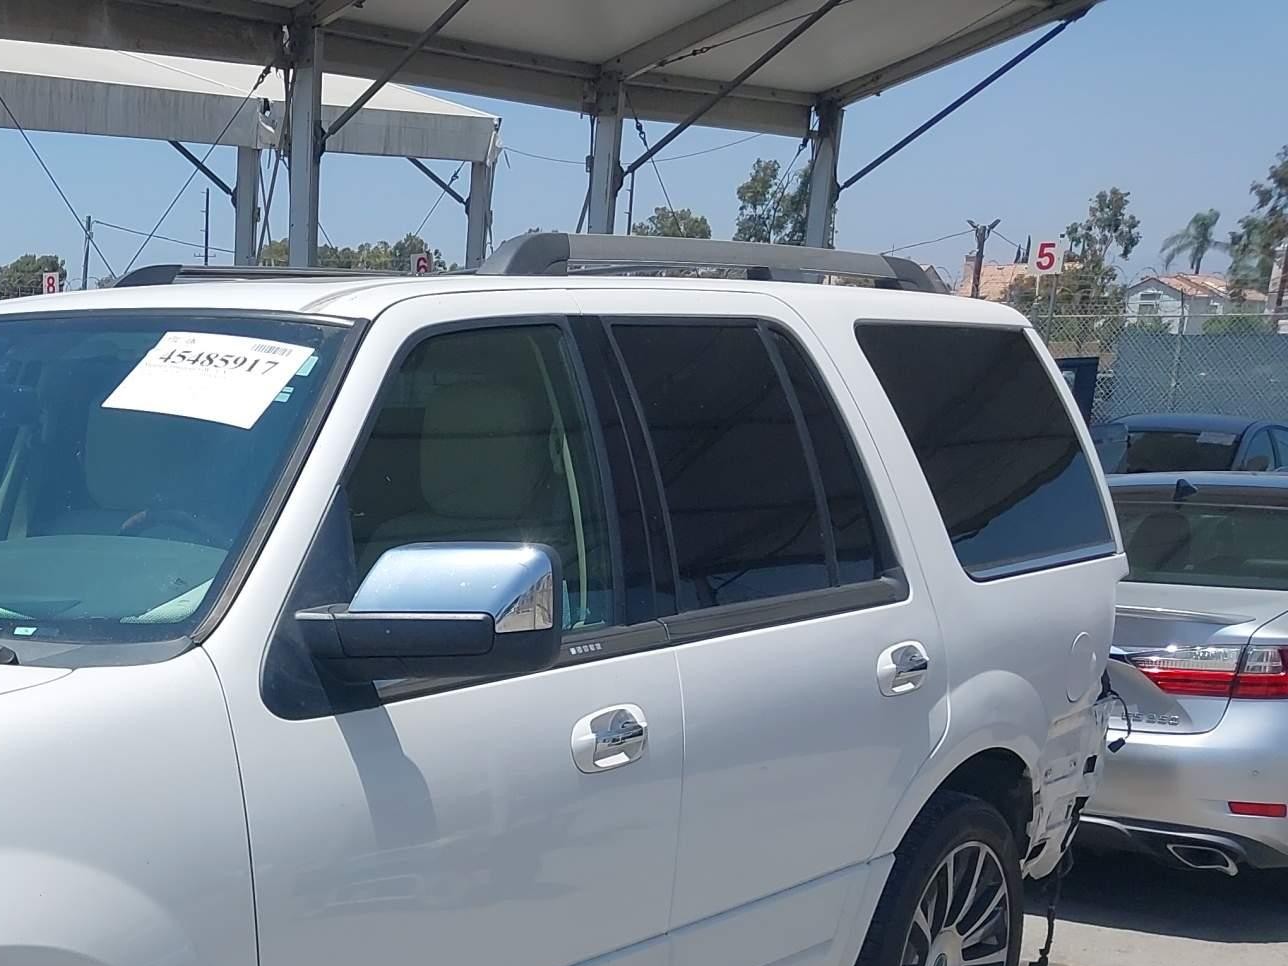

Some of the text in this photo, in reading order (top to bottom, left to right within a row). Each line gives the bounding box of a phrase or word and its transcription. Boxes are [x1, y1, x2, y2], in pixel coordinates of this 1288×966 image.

[1036, 242, 1056, 270] 5
[46, 275, 55, 294] 8
[159, 348, 279, 376] 45485917
